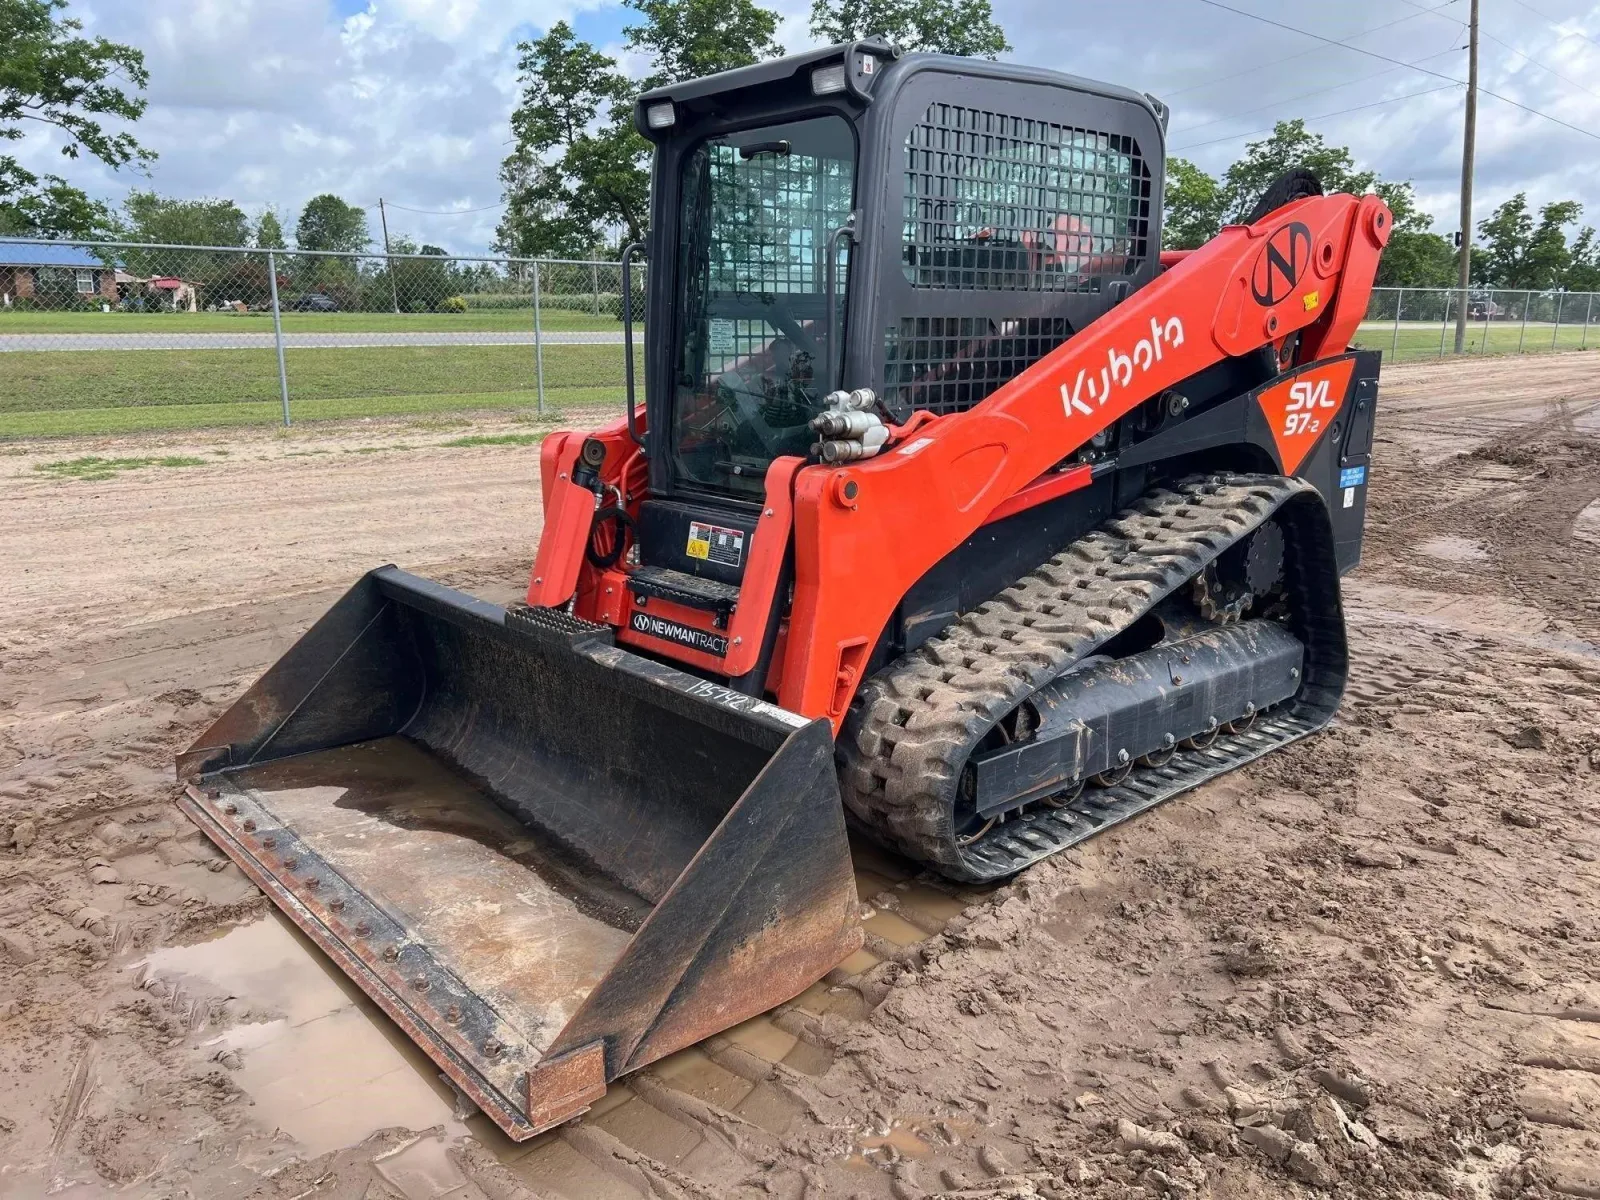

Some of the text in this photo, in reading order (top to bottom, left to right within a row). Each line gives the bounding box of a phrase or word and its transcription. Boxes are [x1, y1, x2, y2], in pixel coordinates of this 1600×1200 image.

[1060, 316, 1184, 418] Kubota
[1285, 380, 1335, 411] SVL
[1283, 412, 1320, 437] 97-2
[685, 680, 748, 710] 195742
